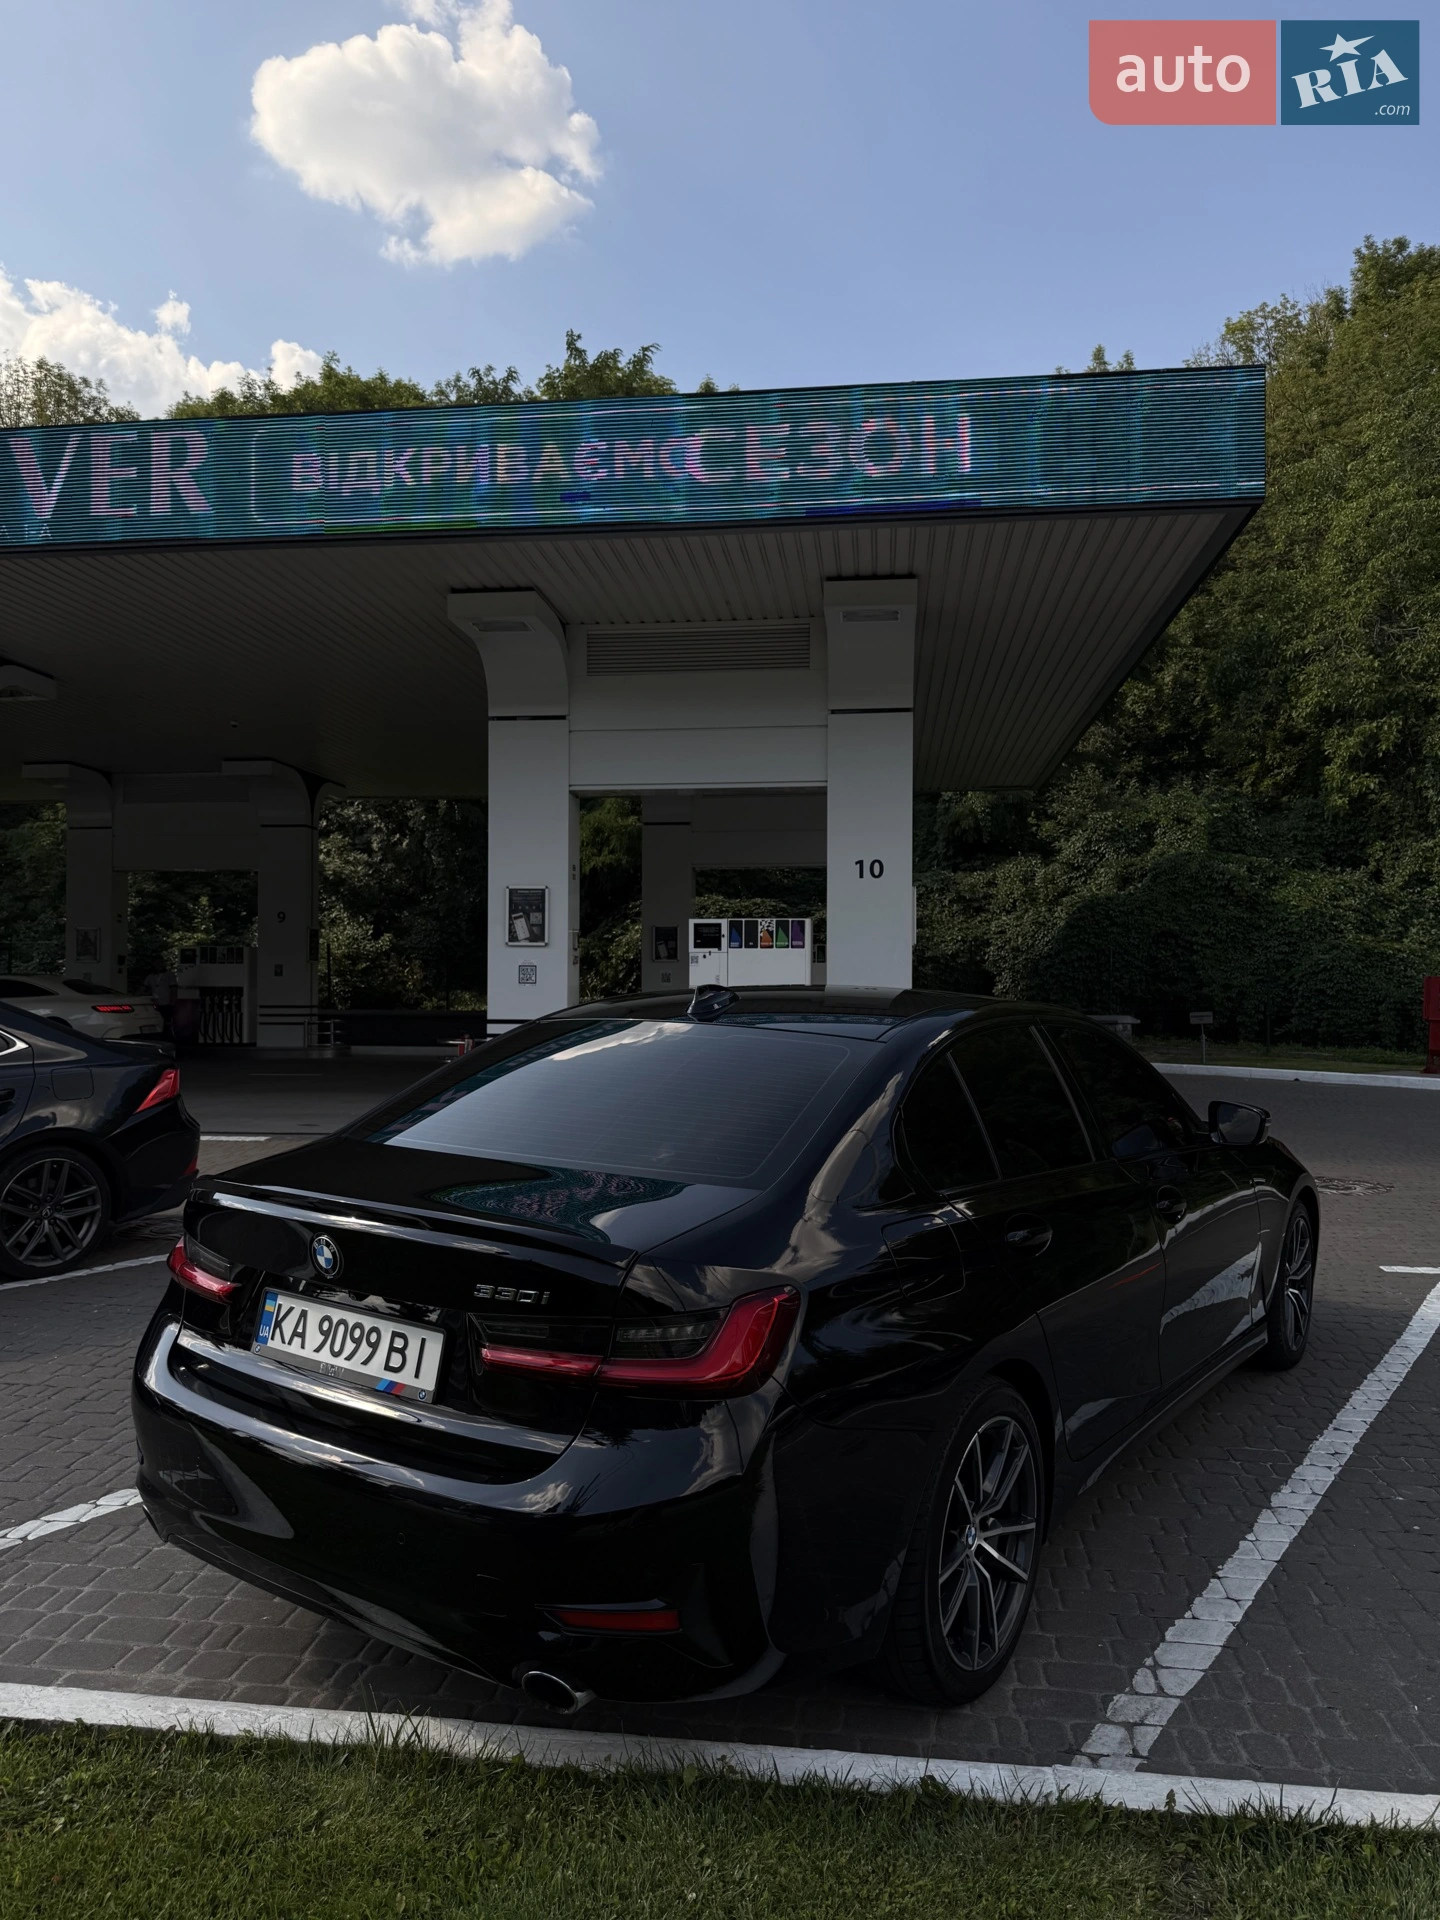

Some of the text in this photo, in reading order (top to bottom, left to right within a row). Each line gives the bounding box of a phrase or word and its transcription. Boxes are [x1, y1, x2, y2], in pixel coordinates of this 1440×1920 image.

[684, 412, 972, 485] СЕЗОН
[854, 858, 885, 880] 10
[277, 911, 286, 924] 9
[473, 1283, 551, 1305] 330i
[259, 1324, 270, 1337] UA
[270, 1303, 427, 1379] KA 9099 BI
